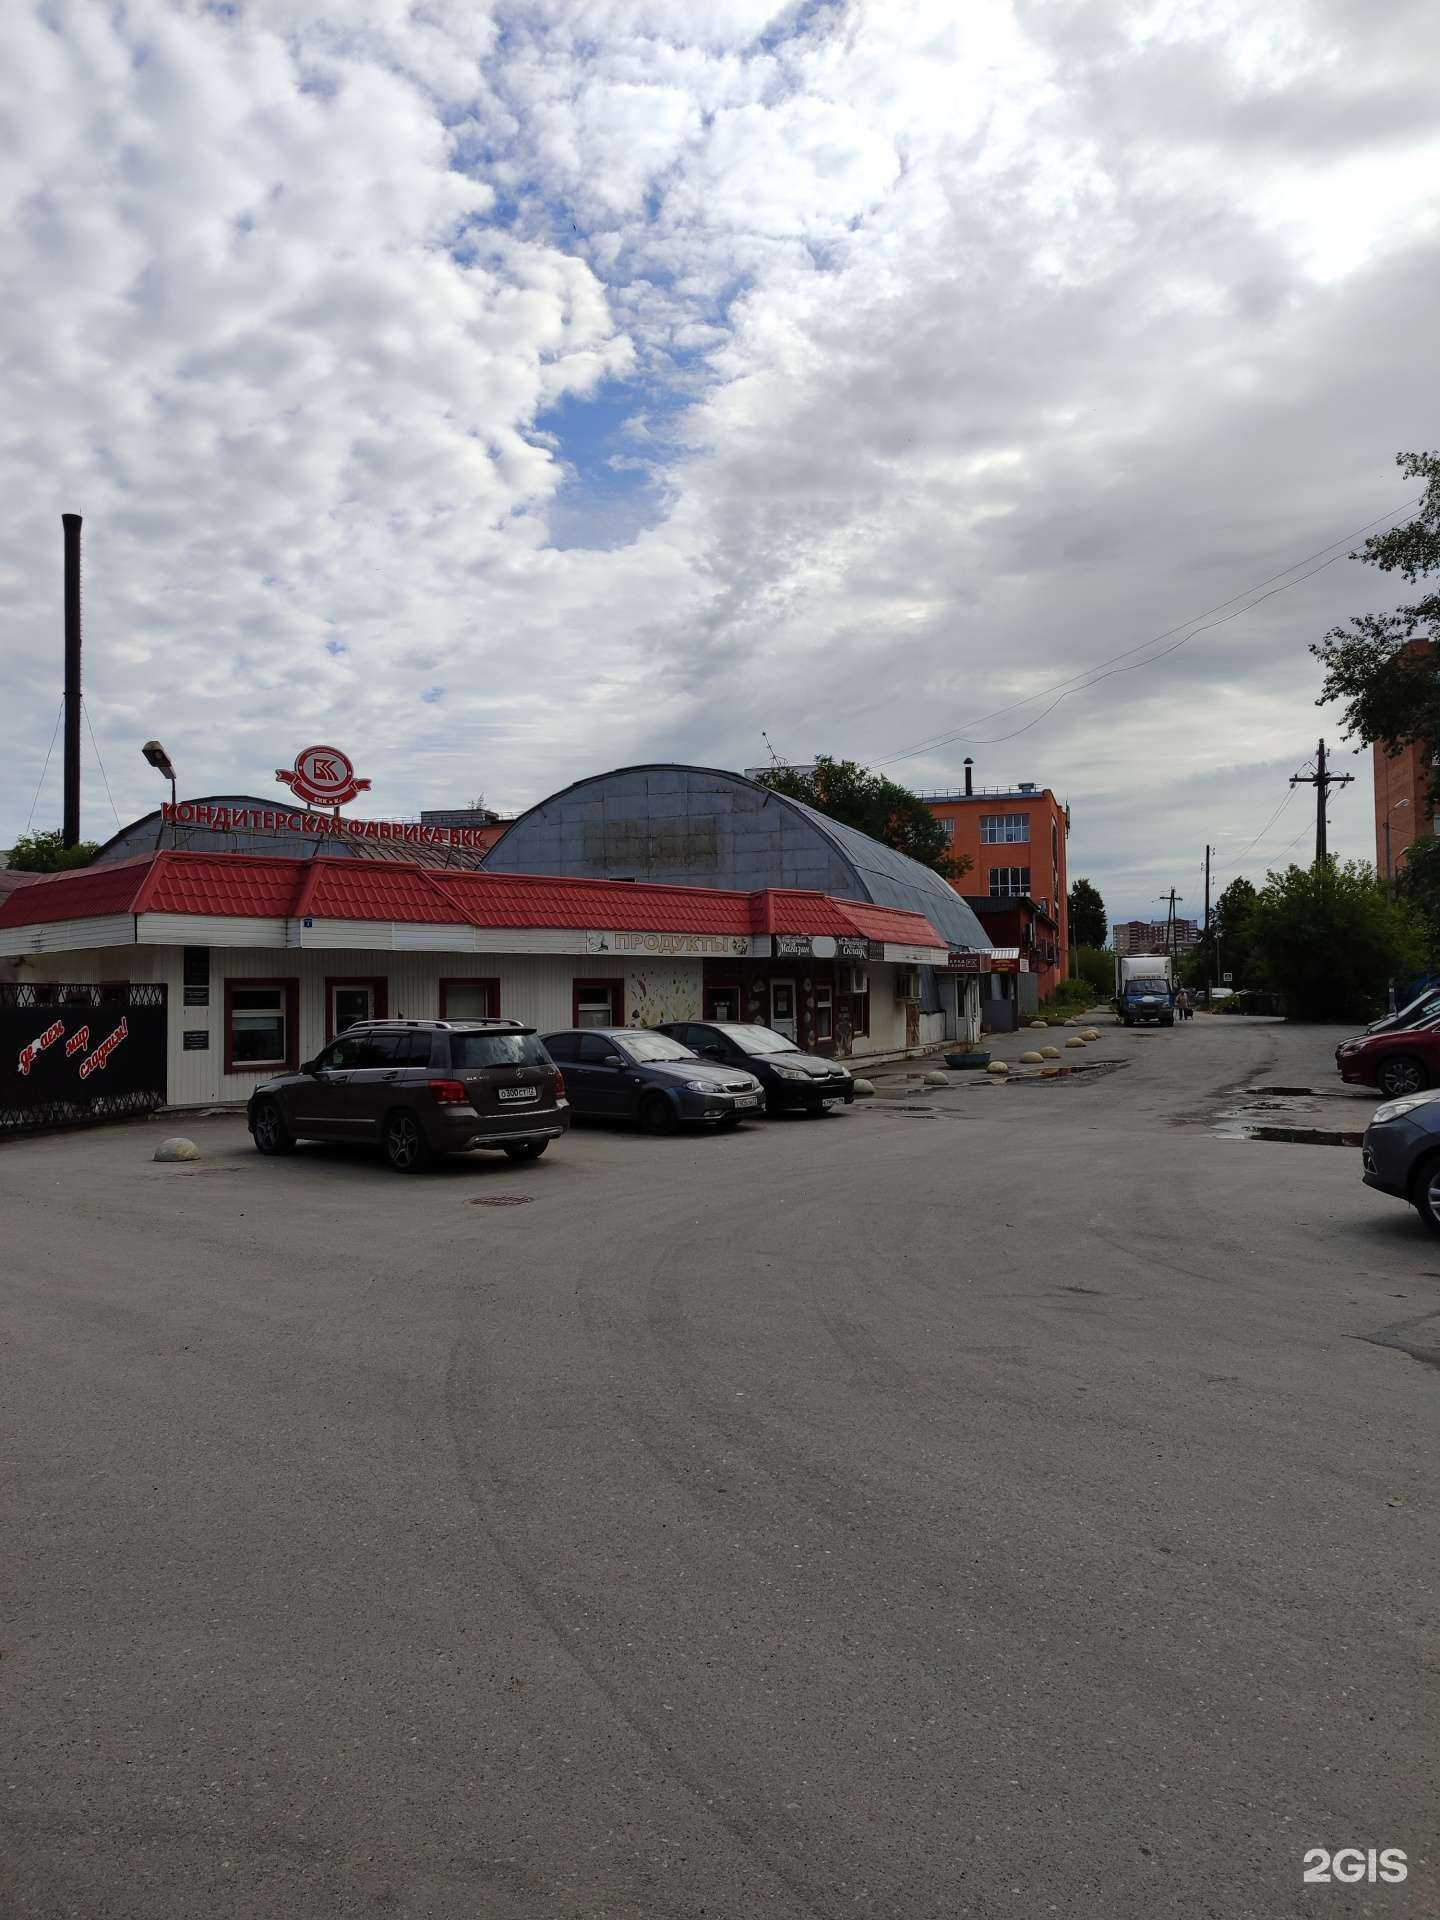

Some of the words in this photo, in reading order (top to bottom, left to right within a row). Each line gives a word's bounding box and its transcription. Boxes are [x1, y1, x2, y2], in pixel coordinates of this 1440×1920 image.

[161, 802, 343, 834] КОНДИТЕРСКАЯ
[348, 819, 443, 844] ФАБРИКА
[615, 932, 729, 953] ПРОДУКТЫ
[18, 1020, 64, 1075] деаем
